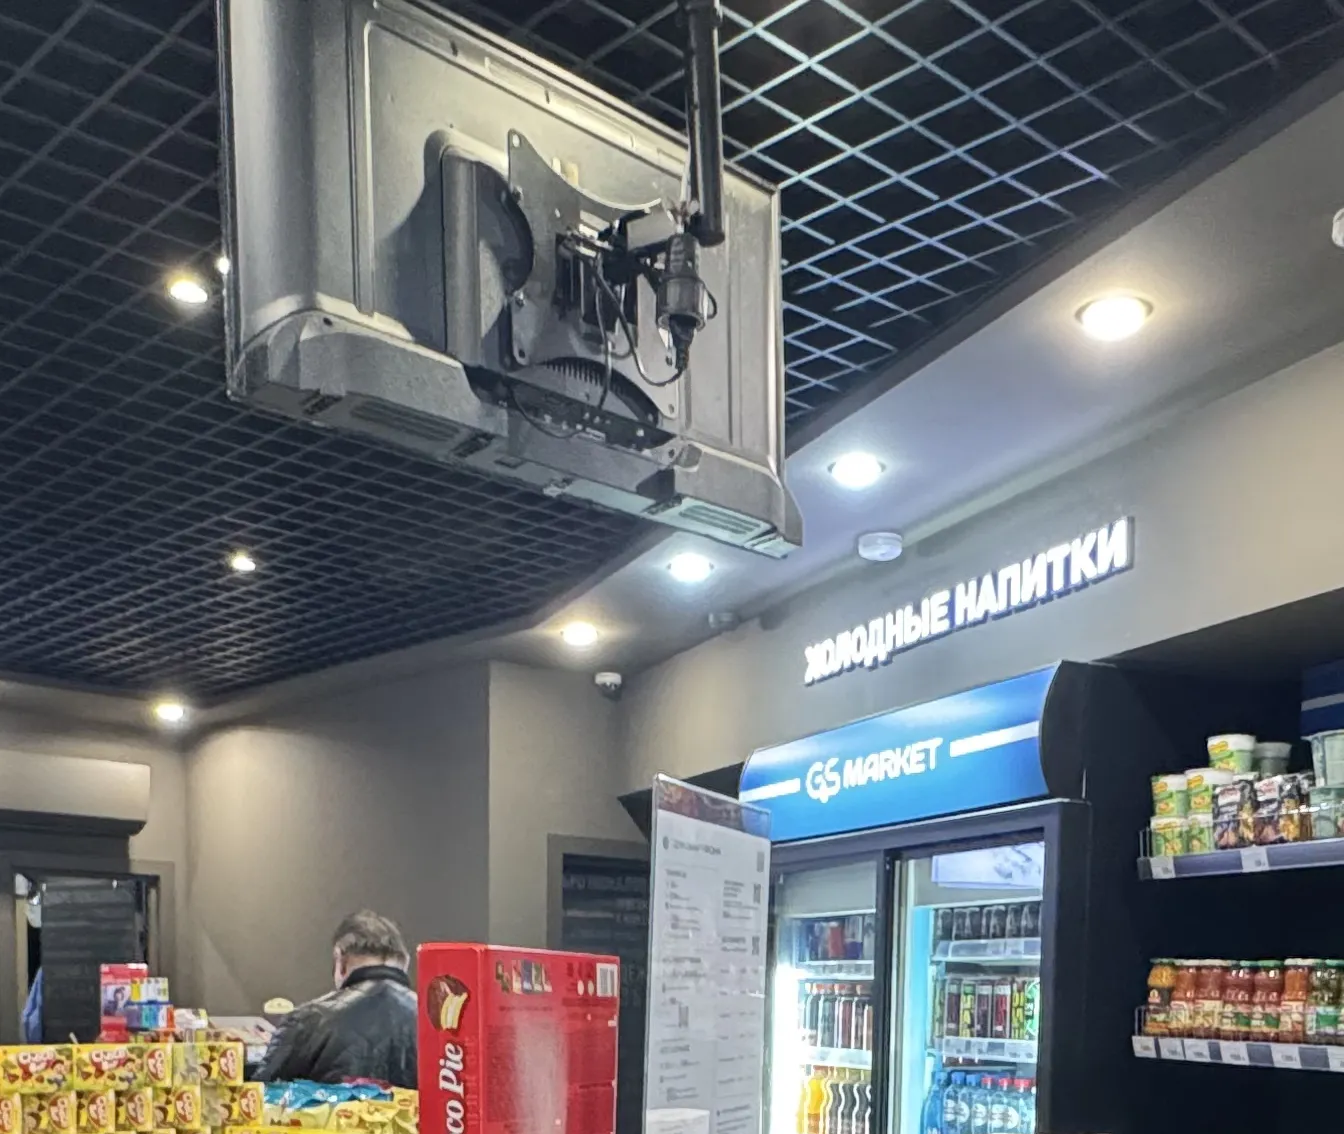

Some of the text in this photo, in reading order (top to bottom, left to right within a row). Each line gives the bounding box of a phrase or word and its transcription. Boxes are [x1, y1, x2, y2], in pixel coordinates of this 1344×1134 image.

[804, 516, 1133, 685] ХОЛОДНЫЕ НАПИТКИ
[805, 737, 944, 804] GS MARKET
[439, 1042, 465, 1094] Pie
